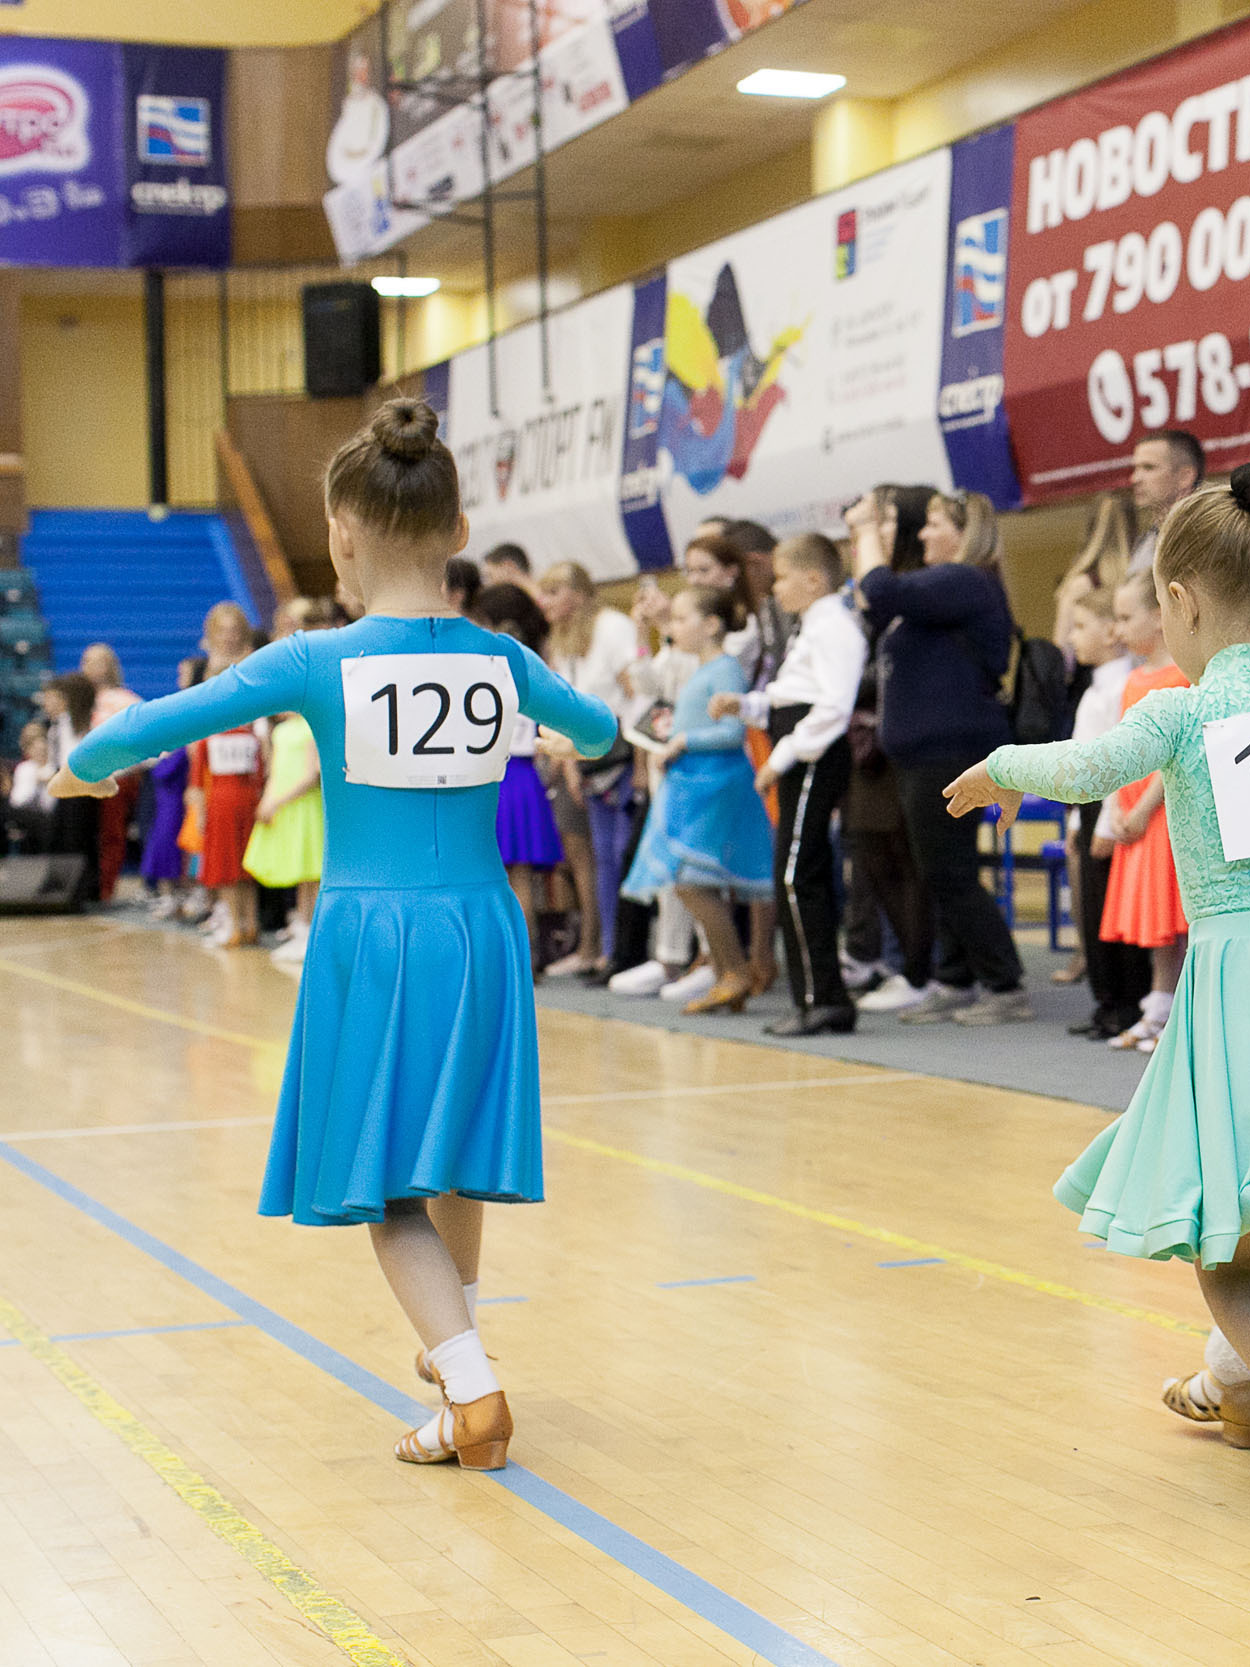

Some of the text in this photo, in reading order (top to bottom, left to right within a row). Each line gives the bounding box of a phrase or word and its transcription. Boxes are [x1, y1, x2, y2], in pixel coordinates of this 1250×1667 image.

[1021, 268, 1078, 338] от
[1082, 220, 1182, 322] 790
[371, 682, 503, 756] 129
